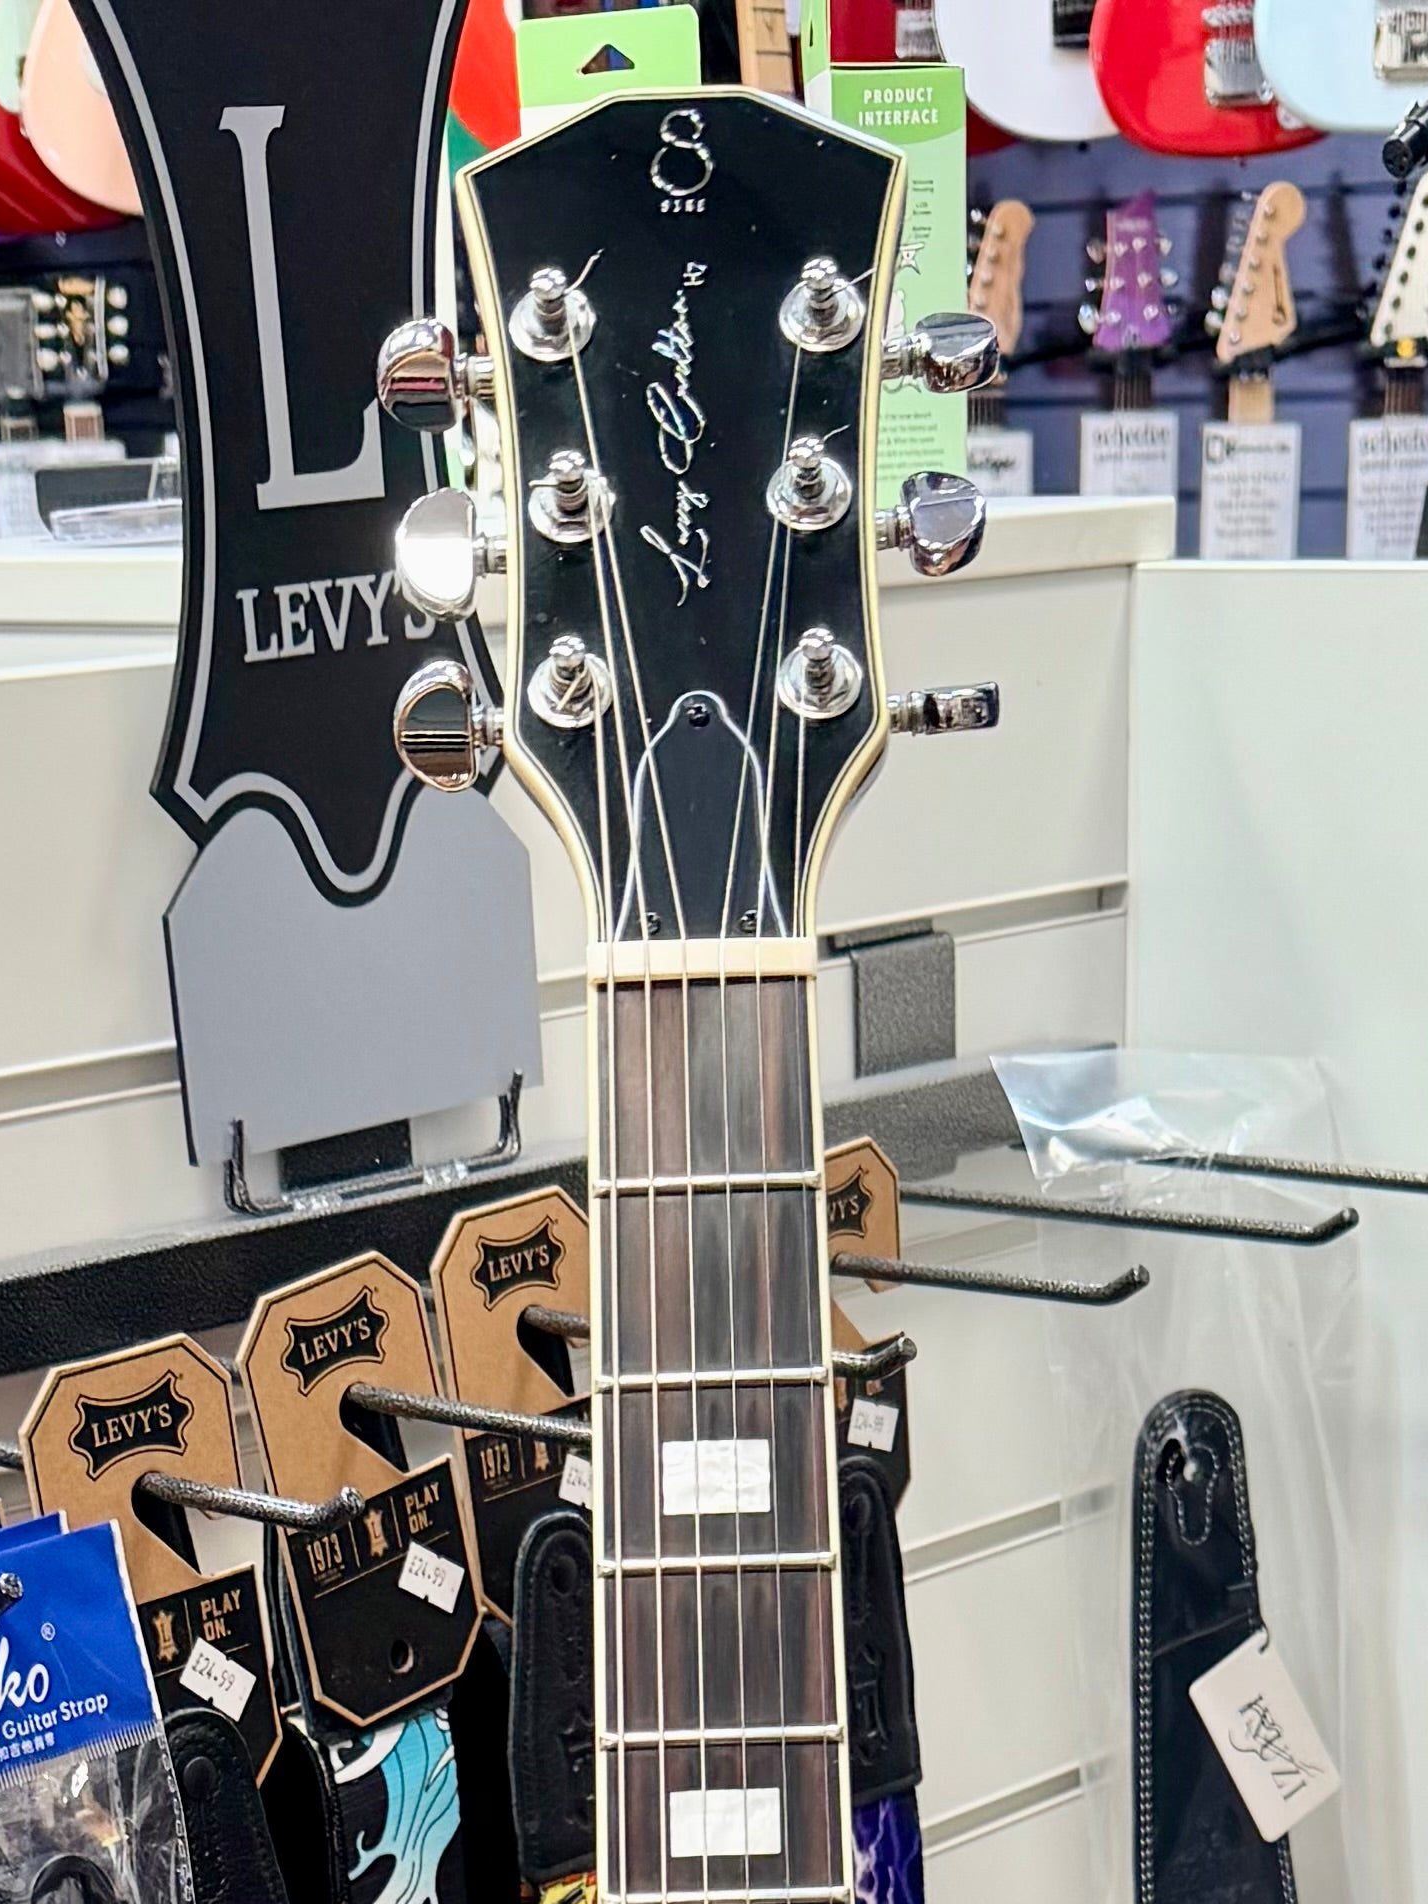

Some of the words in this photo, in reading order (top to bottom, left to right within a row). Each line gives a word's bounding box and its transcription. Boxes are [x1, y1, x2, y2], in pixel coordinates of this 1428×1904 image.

[863, 87, 934, 105] PRODUCT
[858, 109, 939, 127] INTERFACE
[218, 105, 386, 510] L
[488, 1244, 550, 1283] LEVY'S
[300, 1317, 371, 1366] LEVY'S
[91, 1403, 174, 1449] LEVY'S
[480, 1442, 511, 1480] 1973
[404, 1481, 440, 1516] PLAY
[408, 1509, 434, 1534] ON.
[306, 1532, 344, 1576] 1973
[200, 1589, 241, 1621] PLAY
[203, 1617, 232, 1641] ON.
[1, 1710, 58, 1741] Guitar
[61, 1693, 109, 1723] Strap
